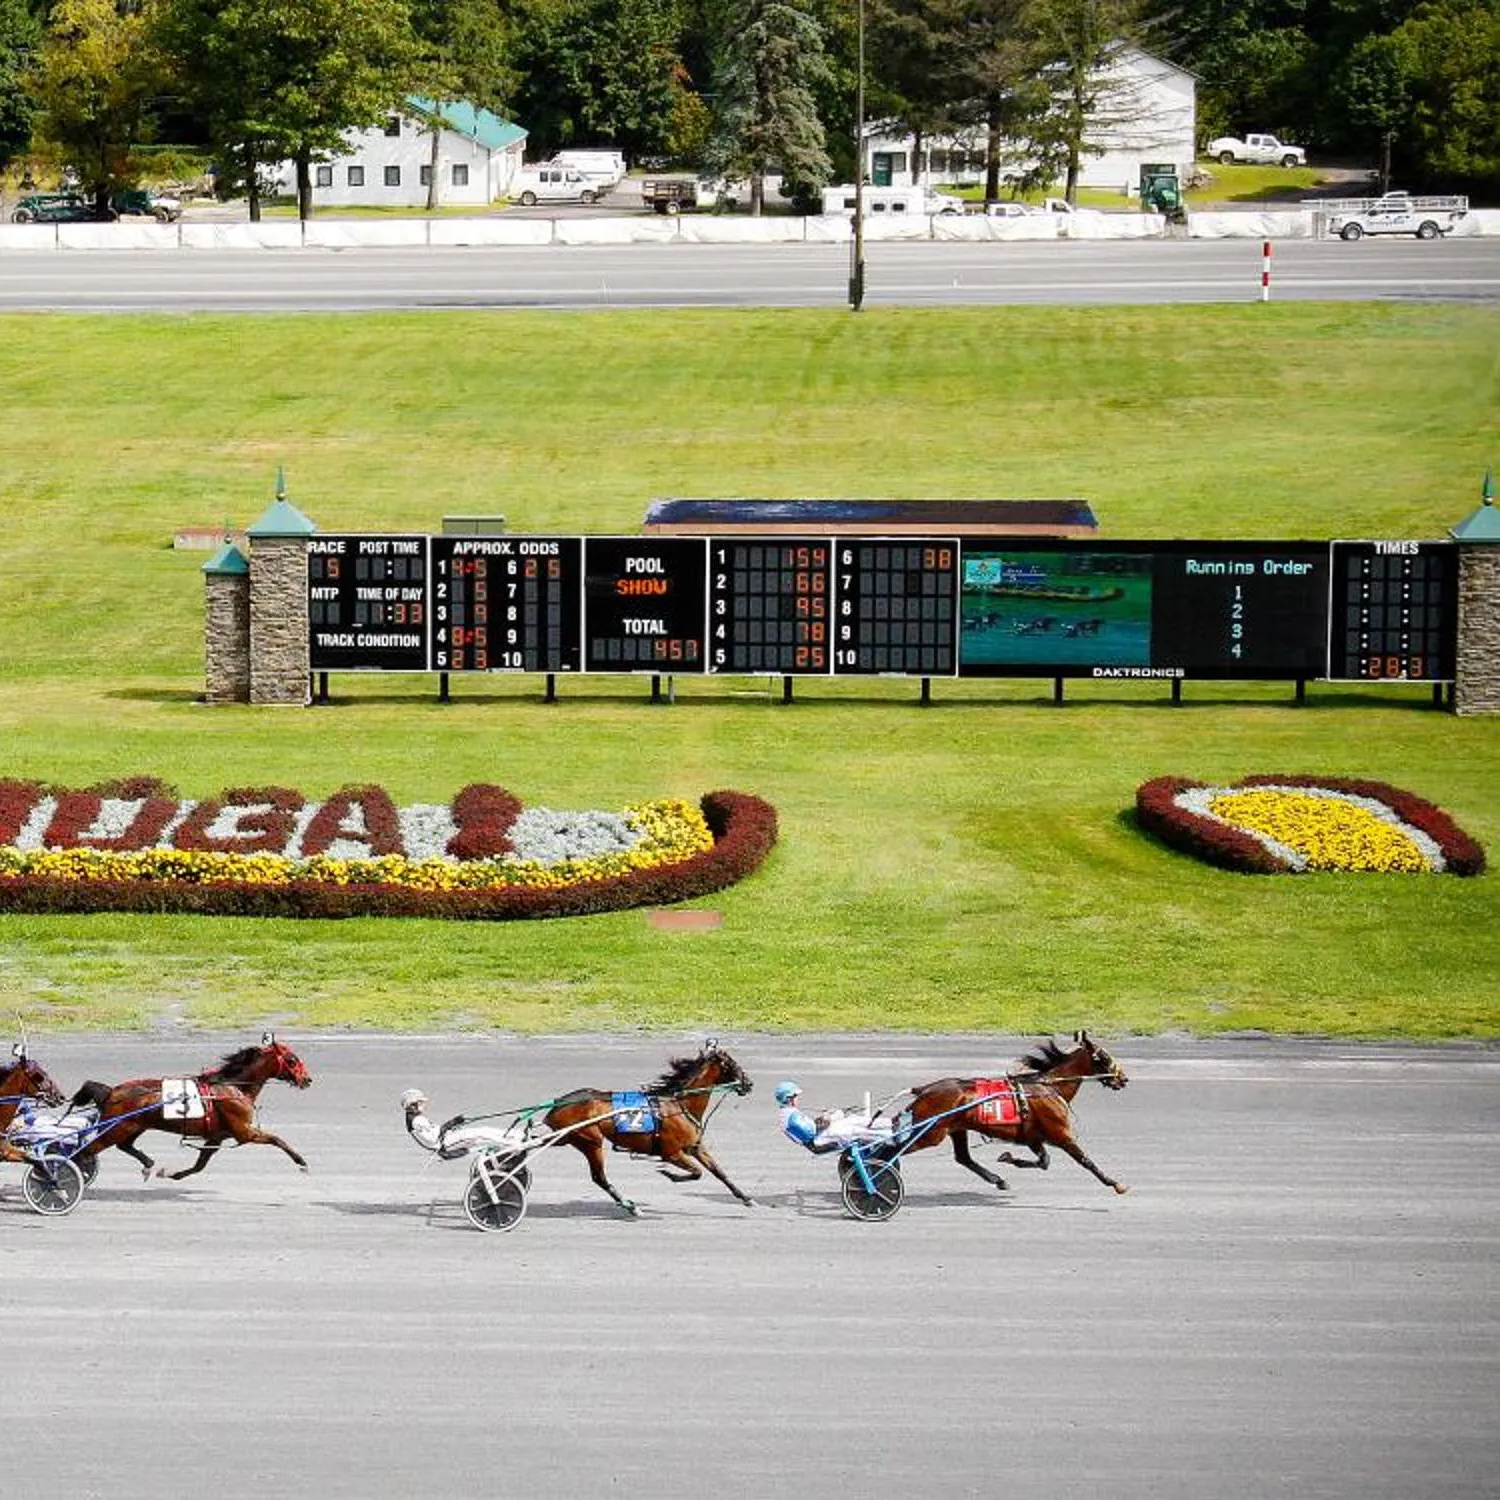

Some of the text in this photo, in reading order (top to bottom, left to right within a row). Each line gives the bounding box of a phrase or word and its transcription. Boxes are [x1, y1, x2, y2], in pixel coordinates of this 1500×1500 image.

[308, 541, 346, 553] RACE
[360, 541, 420, 554] POST TIME
[453, 541, 560, 555] APPROX. ODDS
[1373, 541, 1420, 555] TIMES
[717, 549, 725, 564] 1
[843, 549, 853, 565] 6
[438, 559, 446, 575] 1
[507, 559, 517, 575] 6
[625, 557, 665, 573] POOL
[1186, 559, 1313, 574] Running Order
[616, 578, 668, 595] SHOW
[716, 574, 726, 589] 2
[841, 575, 852, 590] 7
[311, 587, 339, 600] MTP
[356, 587, 423, 600] TIME OF DAY
[437, 583, 447, 598] 2
[507, 583, 517, 598] 7
[1234, 585, 1242, 600] 1
[437, 605, 447, 620] 3
[507, 605, 517, 620] 8
[716, 600, 726, 615] 3
[841, 600, 851, 616] 8
[1231, 603, 1243, 619] 2
[622, 618, 668, 634] TOTAL
[715, 624, 725, 639] 4
[841, 625, 851, 641] 9
[1231, 623, 1243, 639] 3
[316, 633, 420, 648] TRACK CONDITION
[436, 628, 446, 643] 4
[507, 629, 517, 644] 9
[437, 651, 447, 666] 5
[716, 649, 726, 664] 5
[836, 649, 856, 665] 10
[1231, 643, 1242, 659] 4
[501, 651, 522, 667] 10
[1092, 667, 1185, 677] DAKTRONICS
